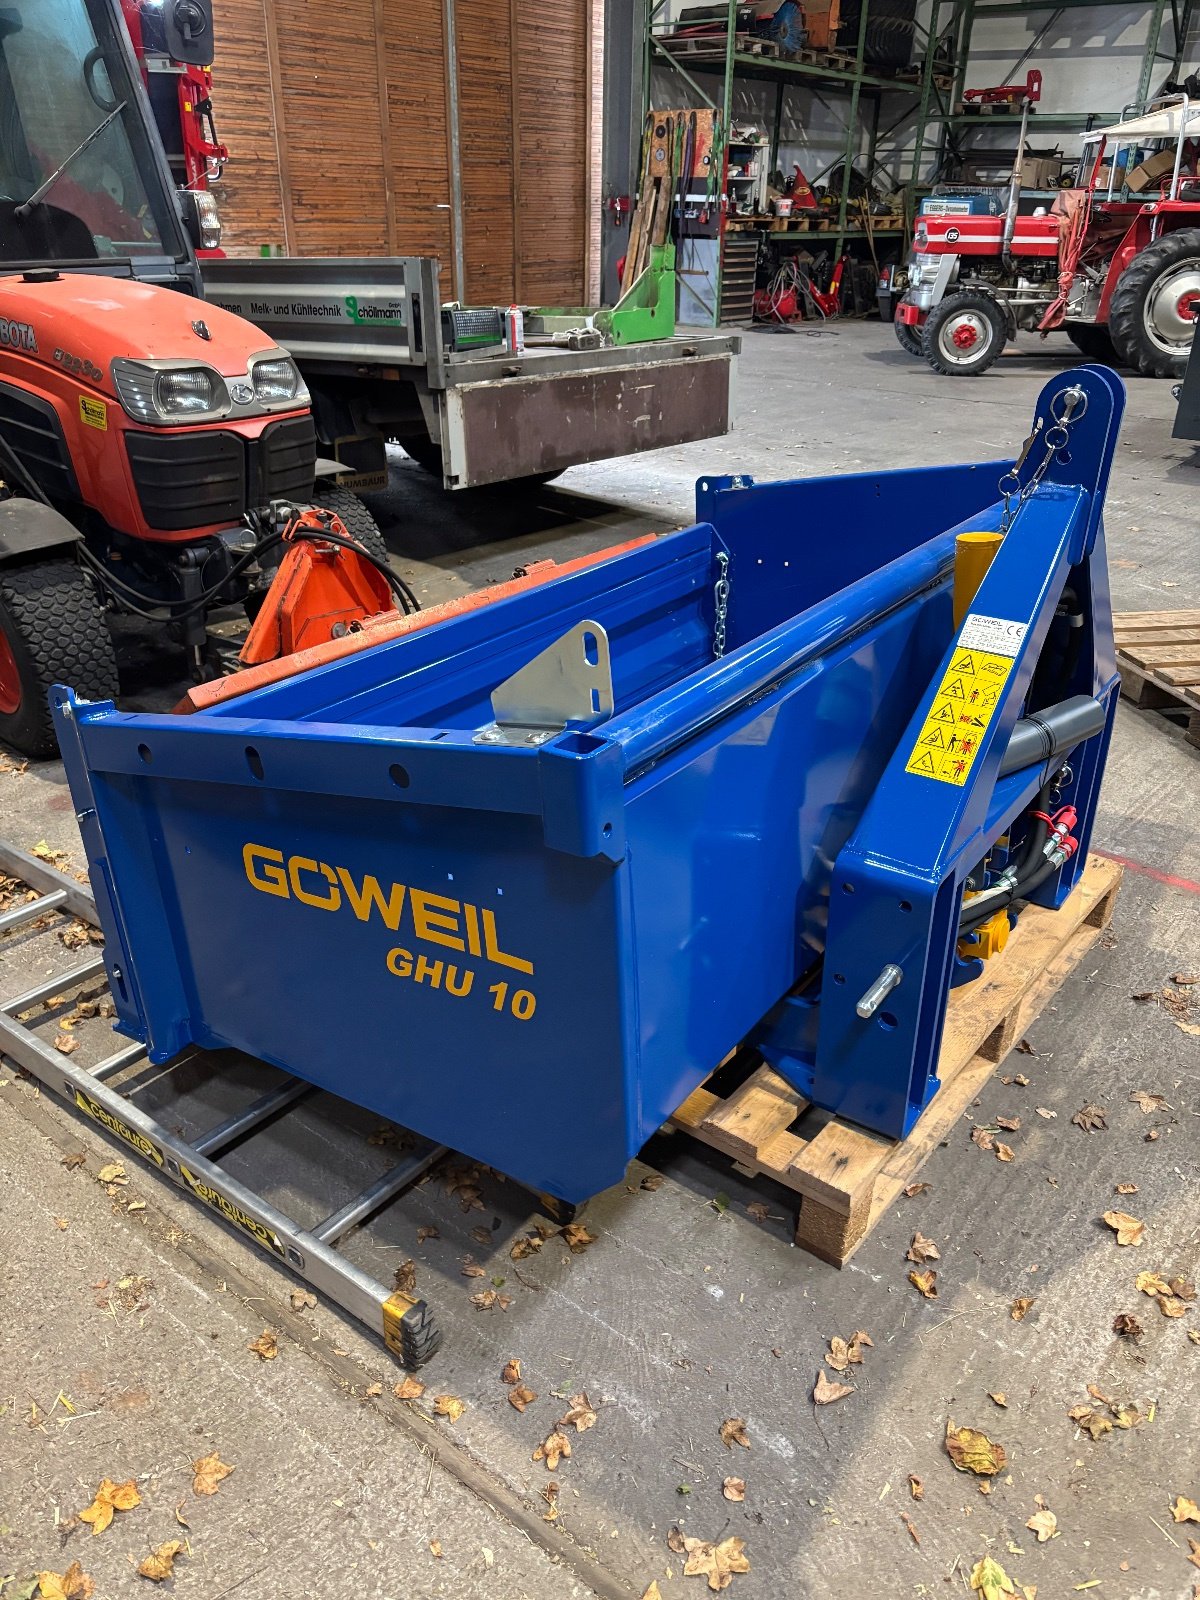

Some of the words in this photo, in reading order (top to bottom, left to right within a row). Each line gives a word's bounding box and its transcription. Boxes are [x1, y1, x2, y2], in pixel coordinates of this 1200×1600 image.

[947, 232, 958, 240] 135
[250, 302, 272, 314] Melk-
[274, 303, 290, 314] und
[291, 303, 342, 316] Kühltechnik
[386, 947, 475, 997] GHU
[489, 981, 537, 1020] 10
[90, 1103, 150, 1151] centaure
[198, 1183, 267, 1239] centaure
